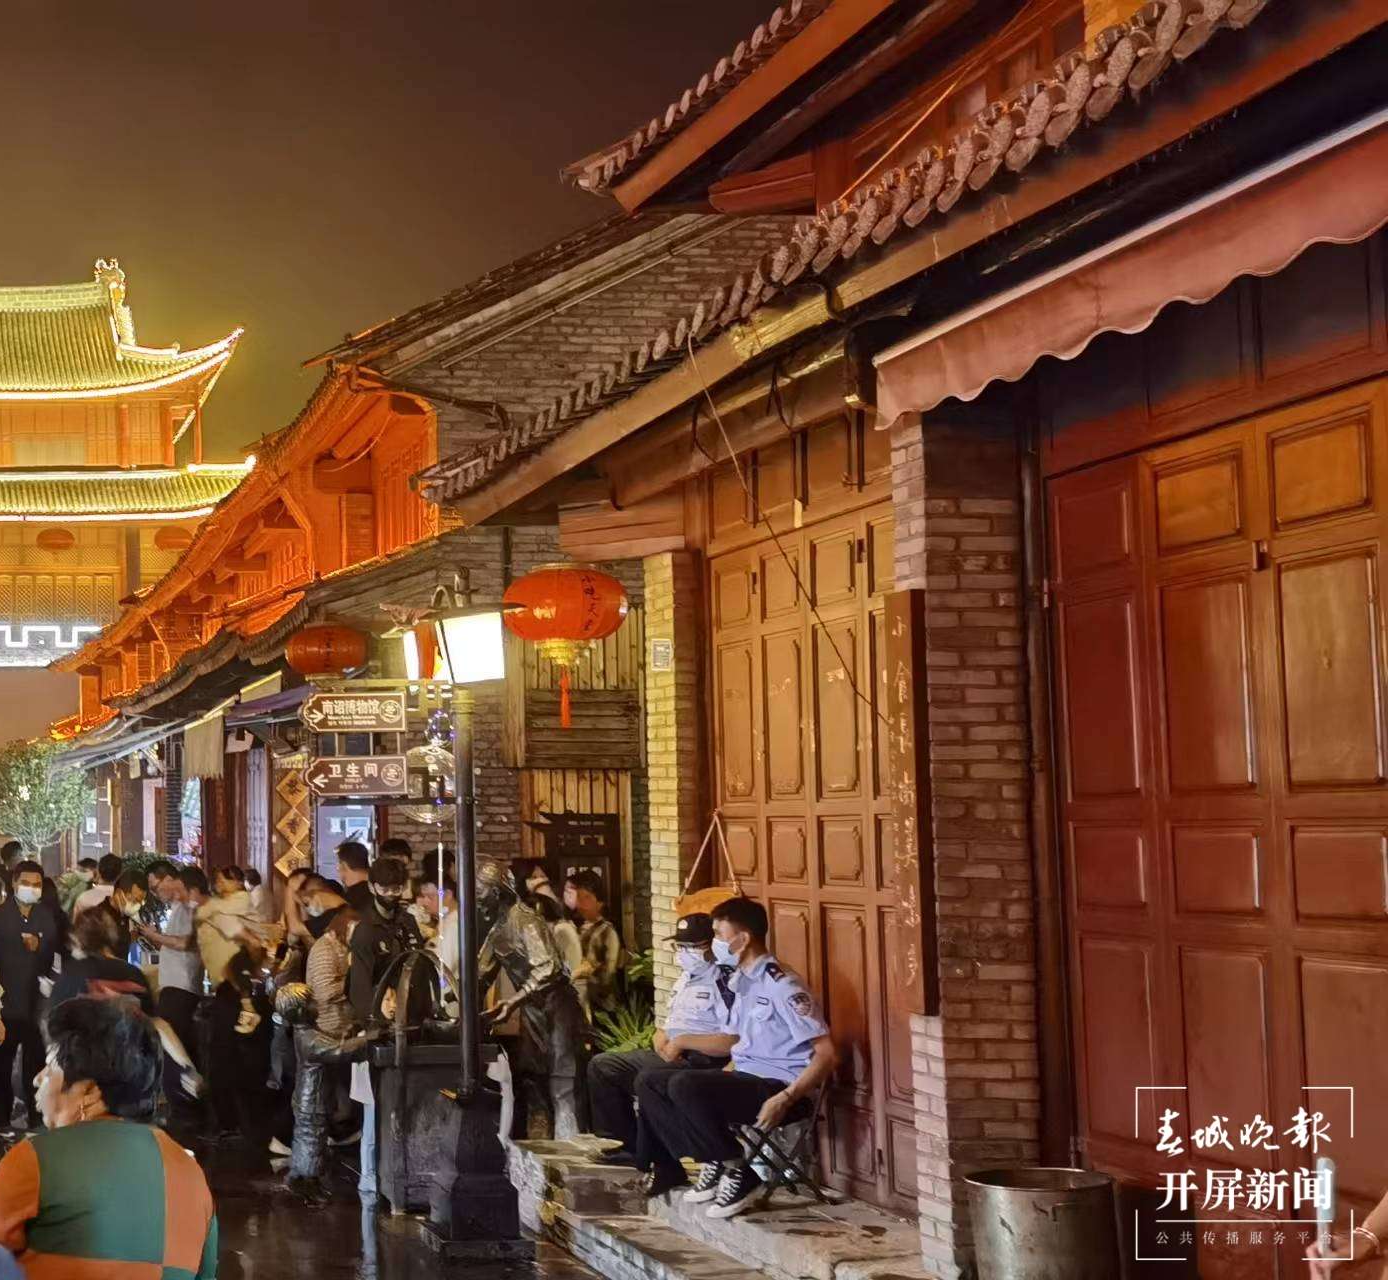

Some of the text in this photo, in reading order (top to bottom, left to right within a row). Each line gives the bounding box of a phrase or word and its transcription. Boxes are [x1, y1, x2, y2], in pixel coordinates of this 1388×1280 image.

[321, 699, 380, 715] 南诏博物馆
[328, 762, 379, 778] 卫生间
